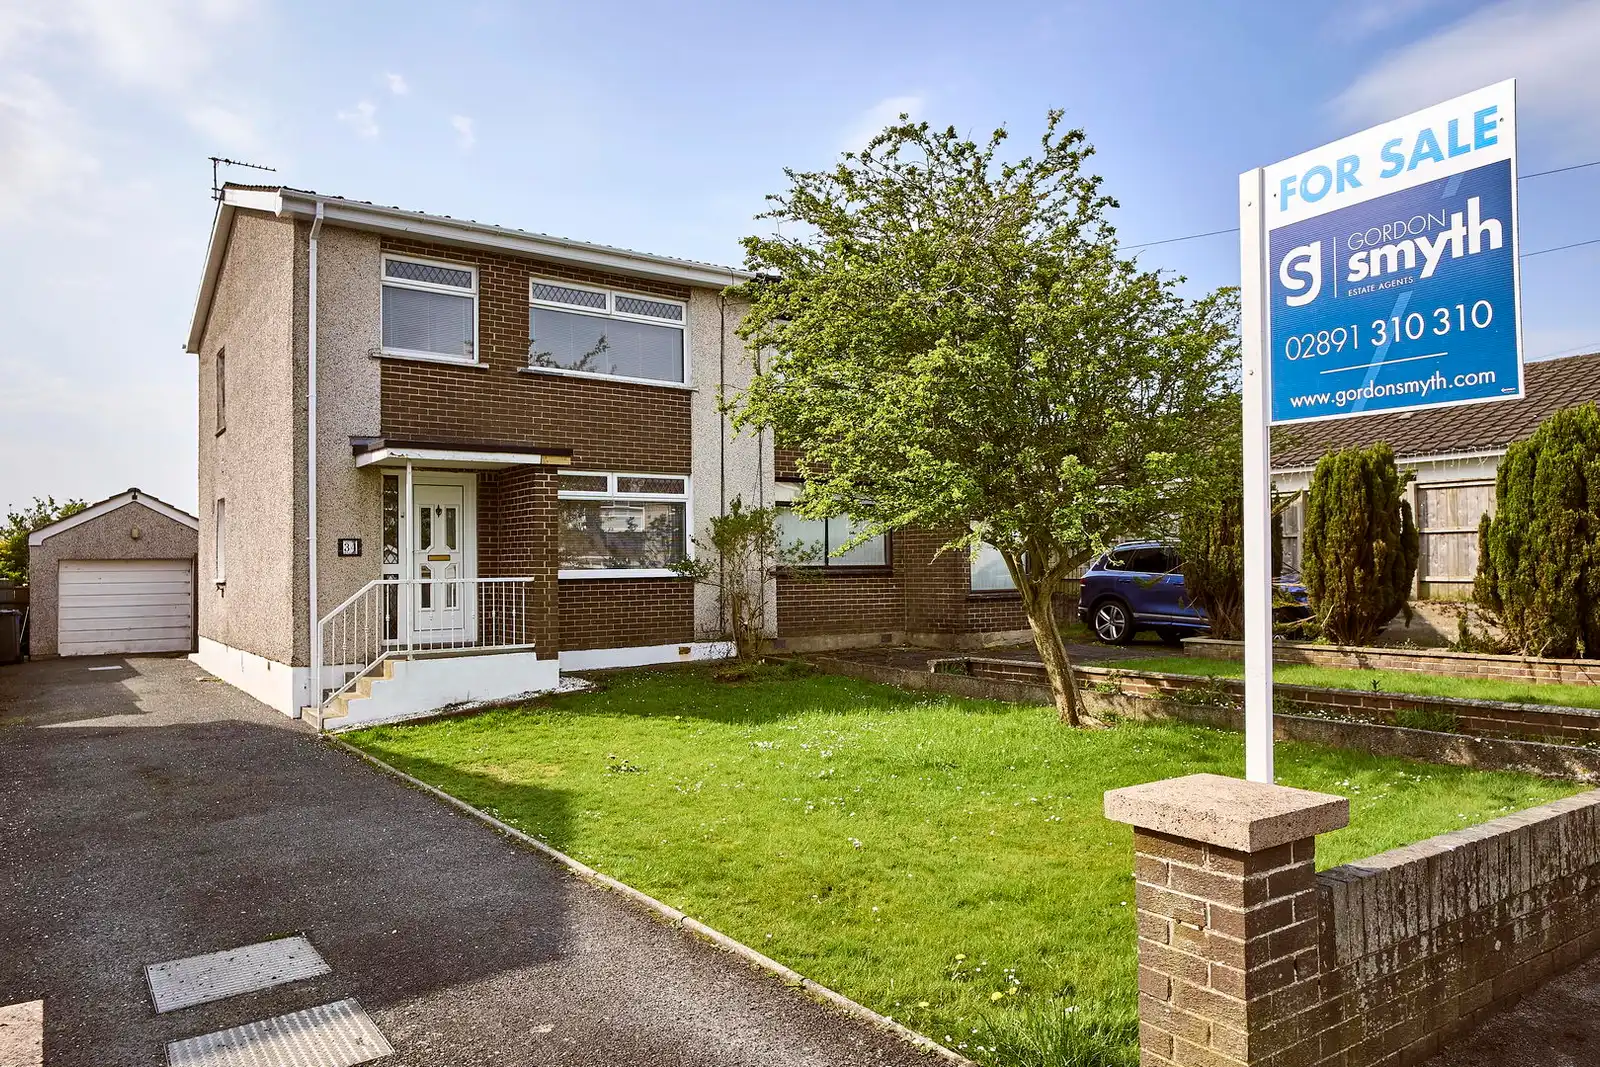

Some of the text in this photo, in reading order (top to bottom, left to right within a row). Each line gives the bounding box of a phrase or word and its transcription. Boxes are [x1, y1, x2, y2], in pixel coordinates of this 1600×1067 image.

[1280, 105, 1498, 212] FOR SALE
[1347, 209, 1446, 251] GORDON
[1347, 196, 1503, 281] smyth
[1348, 276, 1414, 297] ESTATE AGENTS
[1285, 300, 1493, 361] 02891 310 310
[1290, 370, 1496, 408] www.gordonsmyth.com
